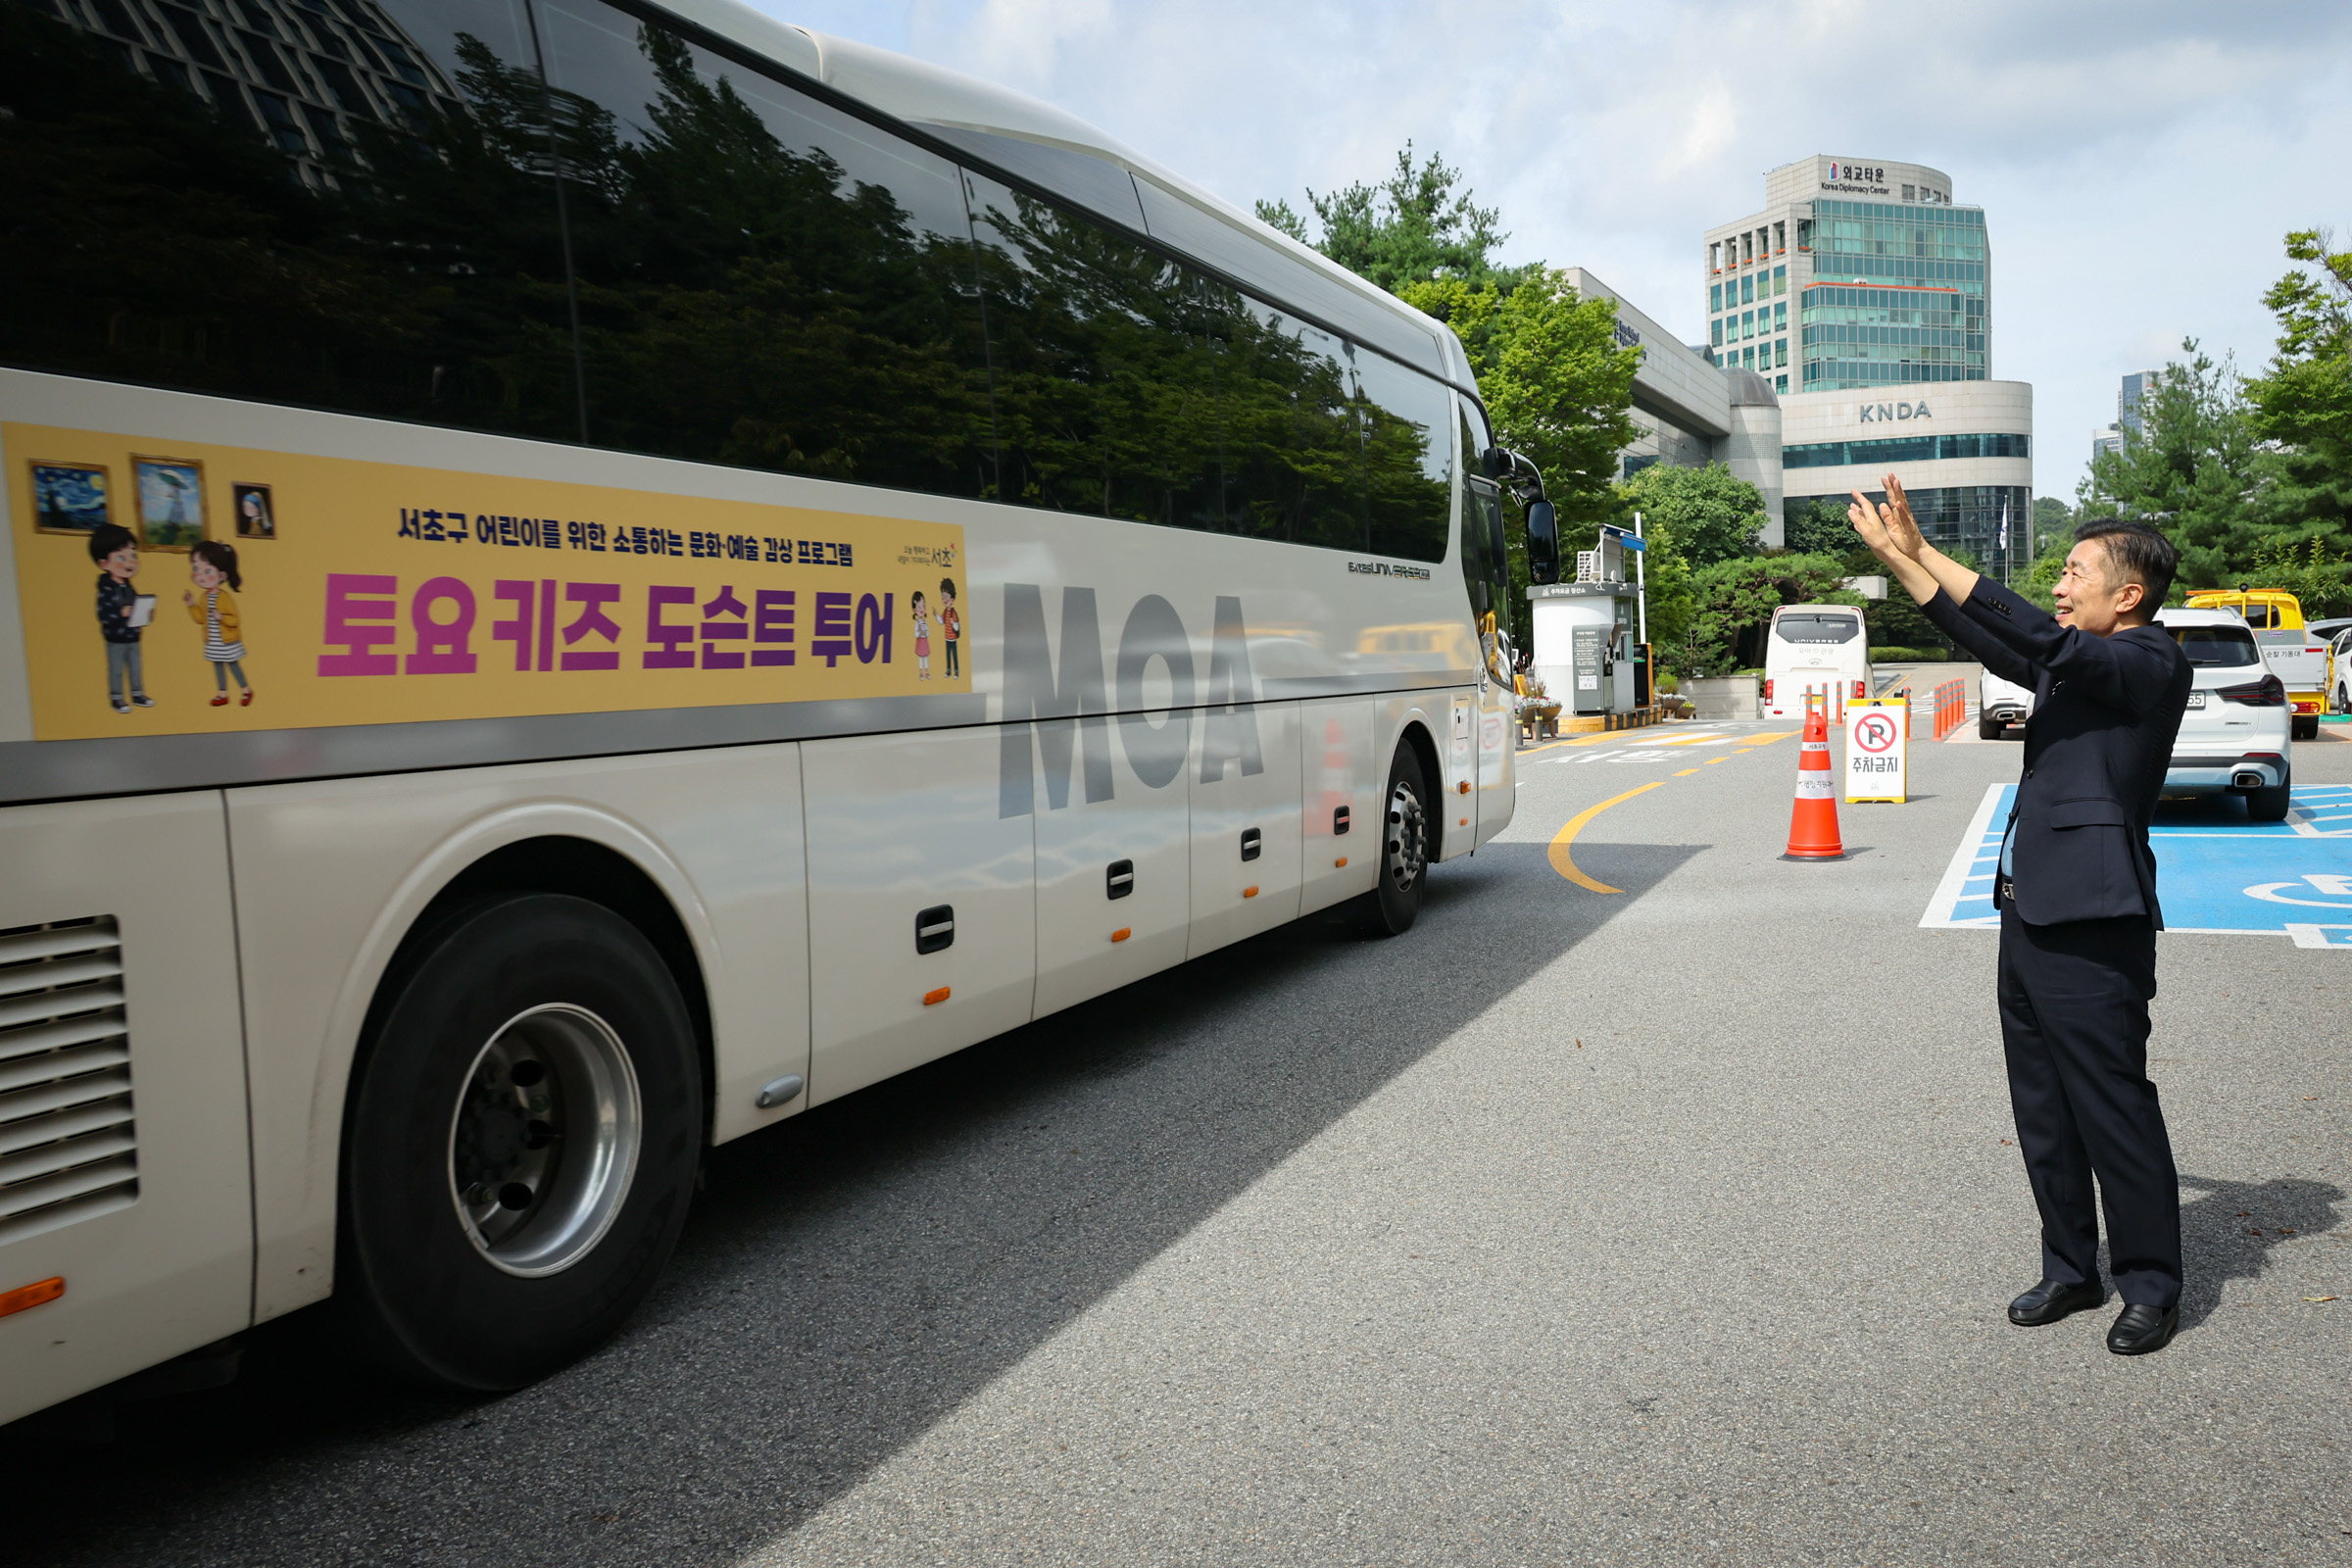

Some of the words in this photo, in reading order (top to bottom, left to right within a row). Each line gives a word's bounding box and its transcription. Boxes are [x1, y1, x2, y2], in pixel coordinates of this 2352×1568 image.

[1843, 166, 1884, 183] 외교타운
[1821, 182, 1838, 191] Korea
[1839, 183, 1869, 194] Diplomacy
[1870, 185, 1889, 194] Center
[1860, 400, 1932, 422] KNDA
[397, 508, 468, 543] 서초구
[476, 514, 562, 549] 어린이를
[567, 520, 607, 552] 위한
[613, 525, 684, 557] 소통하는
[763, 537, 793, 564] 감상
[797, 540, 854, 567] 프로그램
[931, 547, 952, 568] 서초
[642, 585, 796, 670] 도슨트
[810, 591, 894, 668] 투어
[999, 582, 1264, 820] MOA
[1853, 757, 1898, 772] 주차금지
